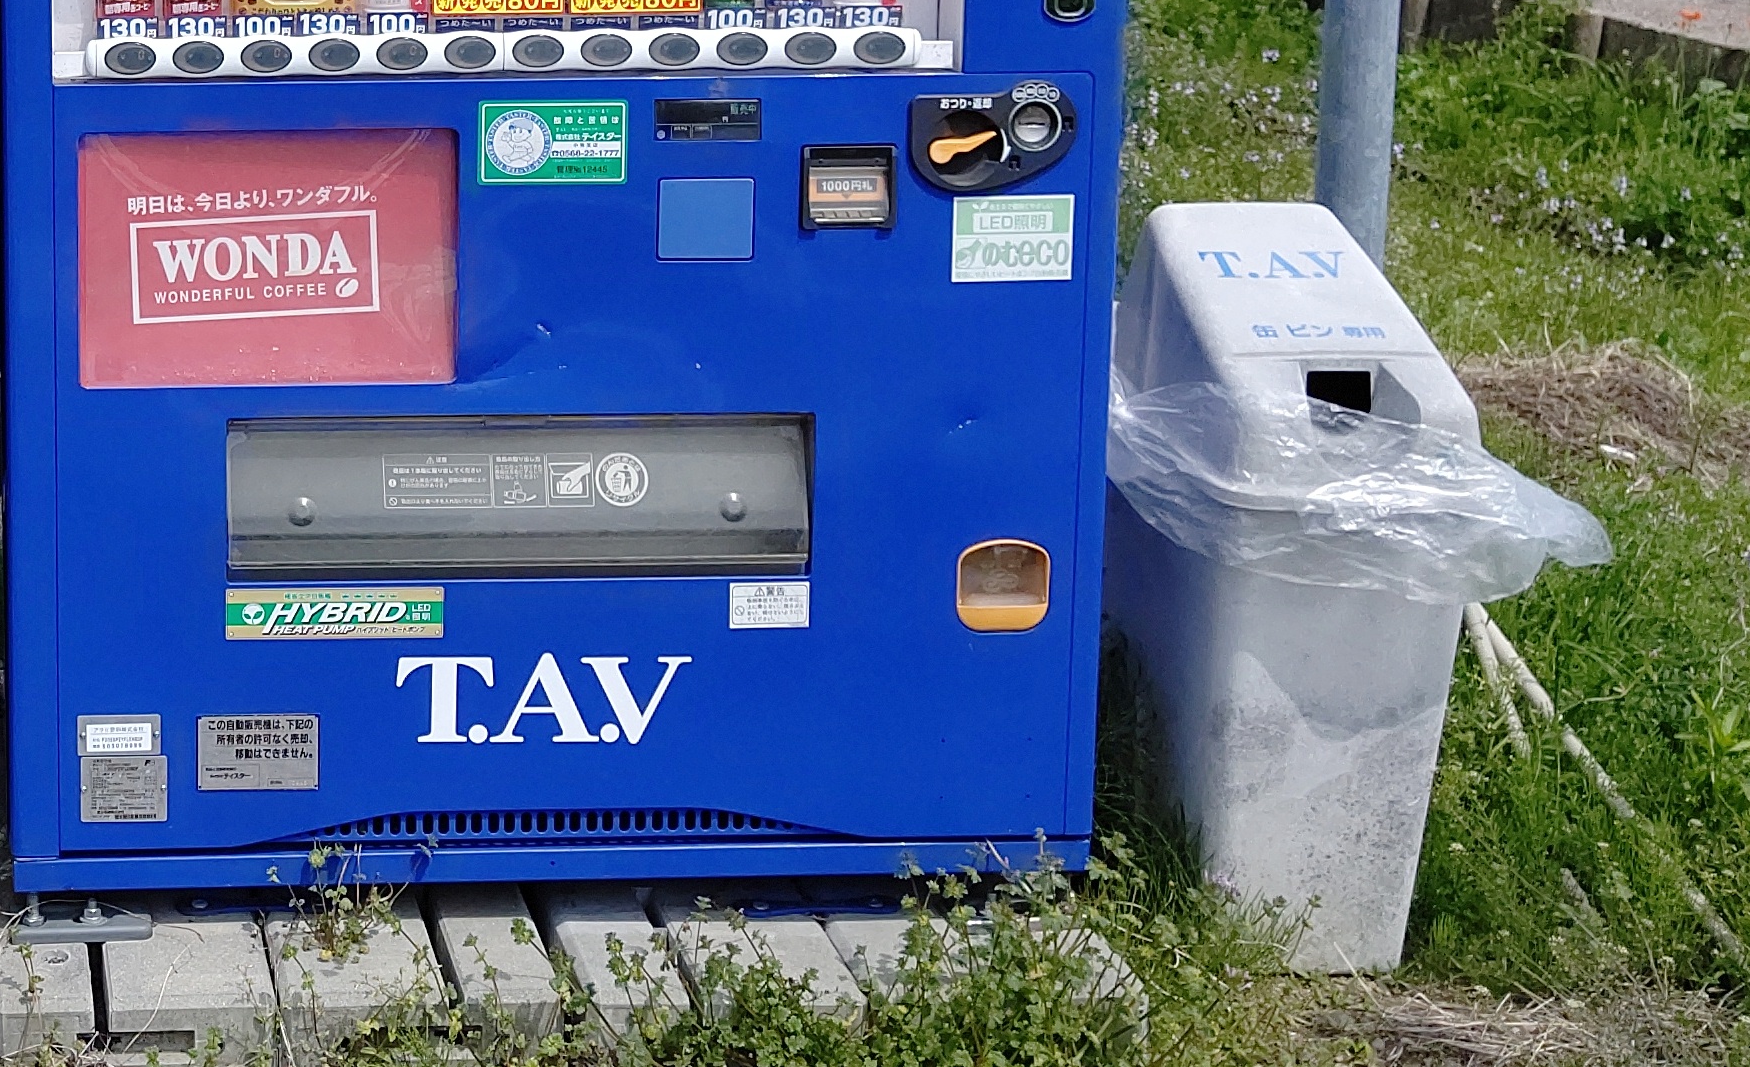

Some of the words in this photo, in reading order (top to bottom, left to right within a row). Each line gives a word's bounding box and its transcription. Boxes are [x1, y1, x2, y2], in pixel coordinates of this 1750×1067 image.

[939, 97, 993, 109] おつり・返却
[582, 132, 622, 142] テイスター
[821, 179, 874, 192] 1000円札
[127, 184, 378, 216] 明日は、今日より、ワンダフル。
[979, 214, 1047, 230] LED照明
[153, 230, 357, 283] WONDA
[1198, 250, 1344, 280] T.A.V
[154, 286, 255, 305] WONDERFUL
[263, 282, 327, 299] COFFEE
[1252, 324, 1279, 339] 缶
[1286, 323, 1334, 338] ビン
[411, 604, 431, 612] LED
[262, 602, 408, 635] HYBRID
[273, 624, 315, 635] HEAT
[316, 624, 356, 634] PUMP
[396, 652, 693, 745] T.A.V
[207, 719, 314, 731] この自動販売機は、下記の
[216, 733, 314, 745] 所有者の許可なく売却、
